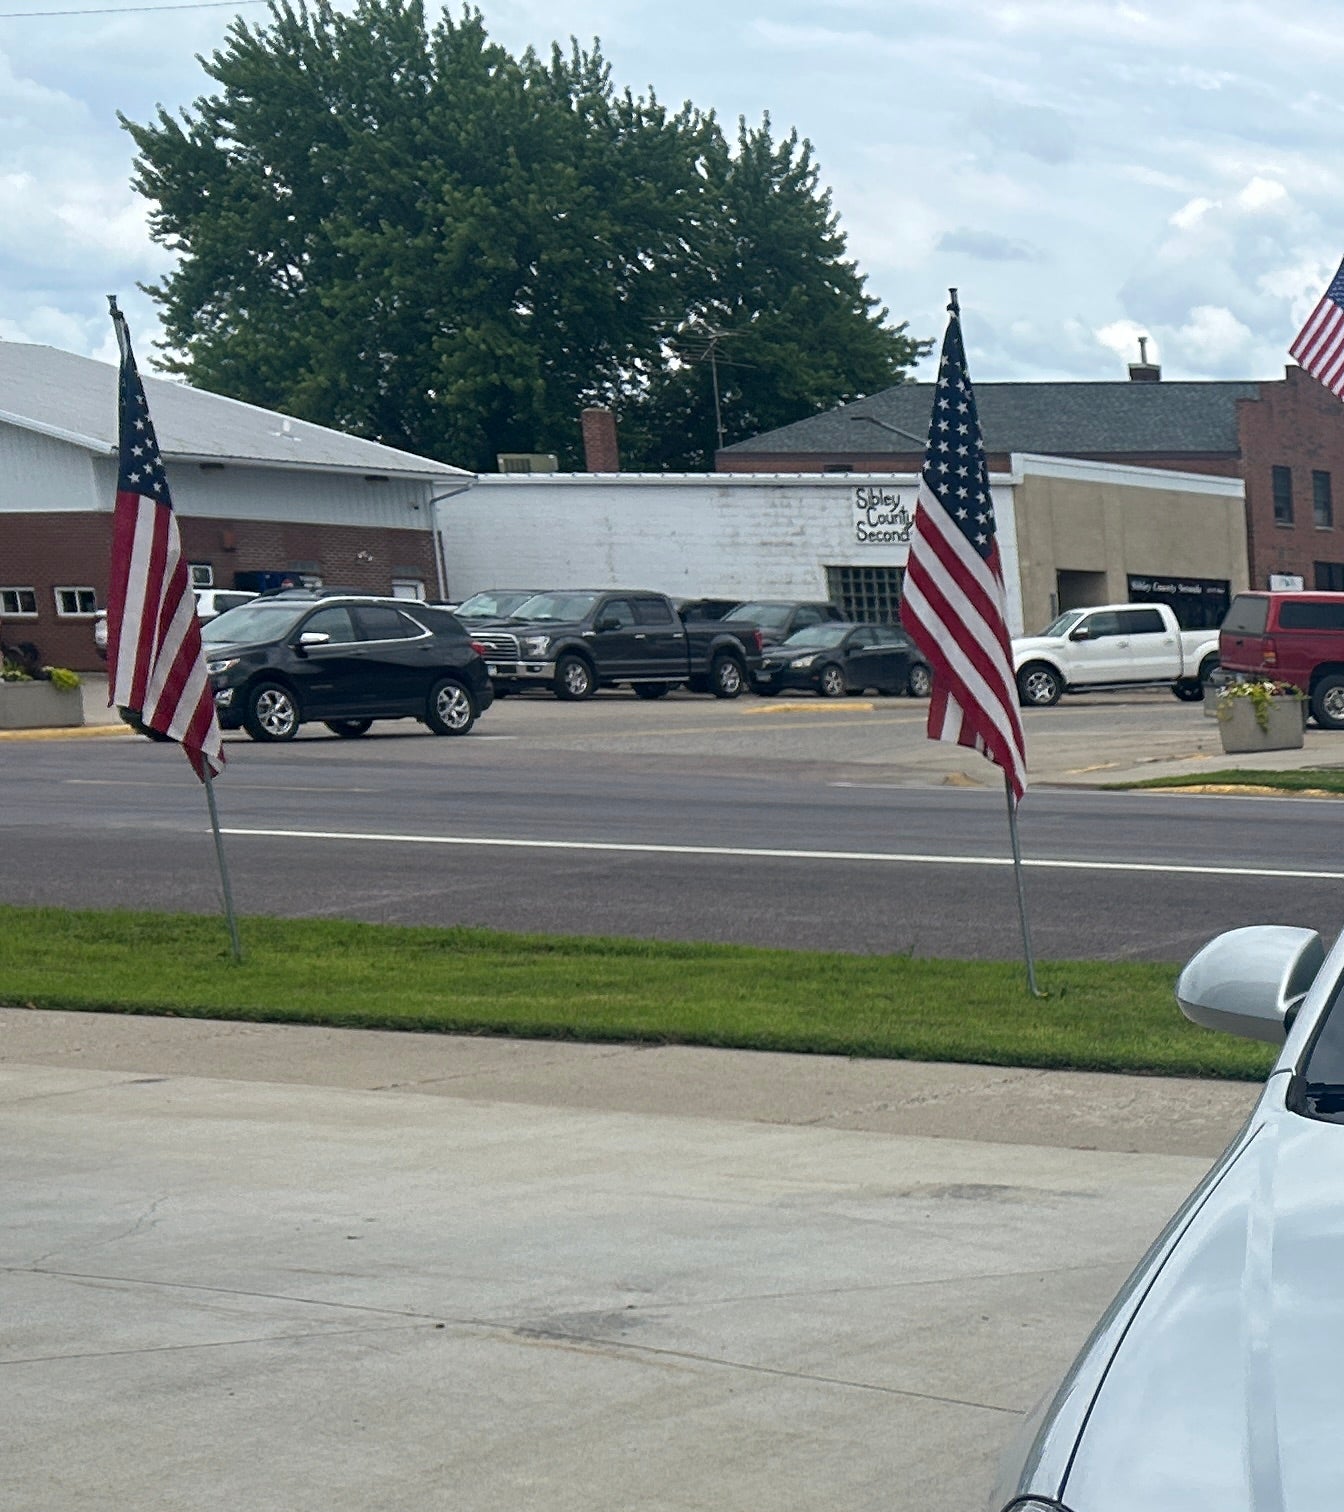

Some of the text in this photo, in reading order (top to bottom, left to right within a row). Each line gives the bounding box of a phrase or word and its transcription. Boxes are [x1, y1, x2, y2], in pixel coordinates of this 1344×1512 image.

[855, 487, 901, 512] Sibley
[866, 504, 915, 531] County
[856, 520, 911, 542] Second
